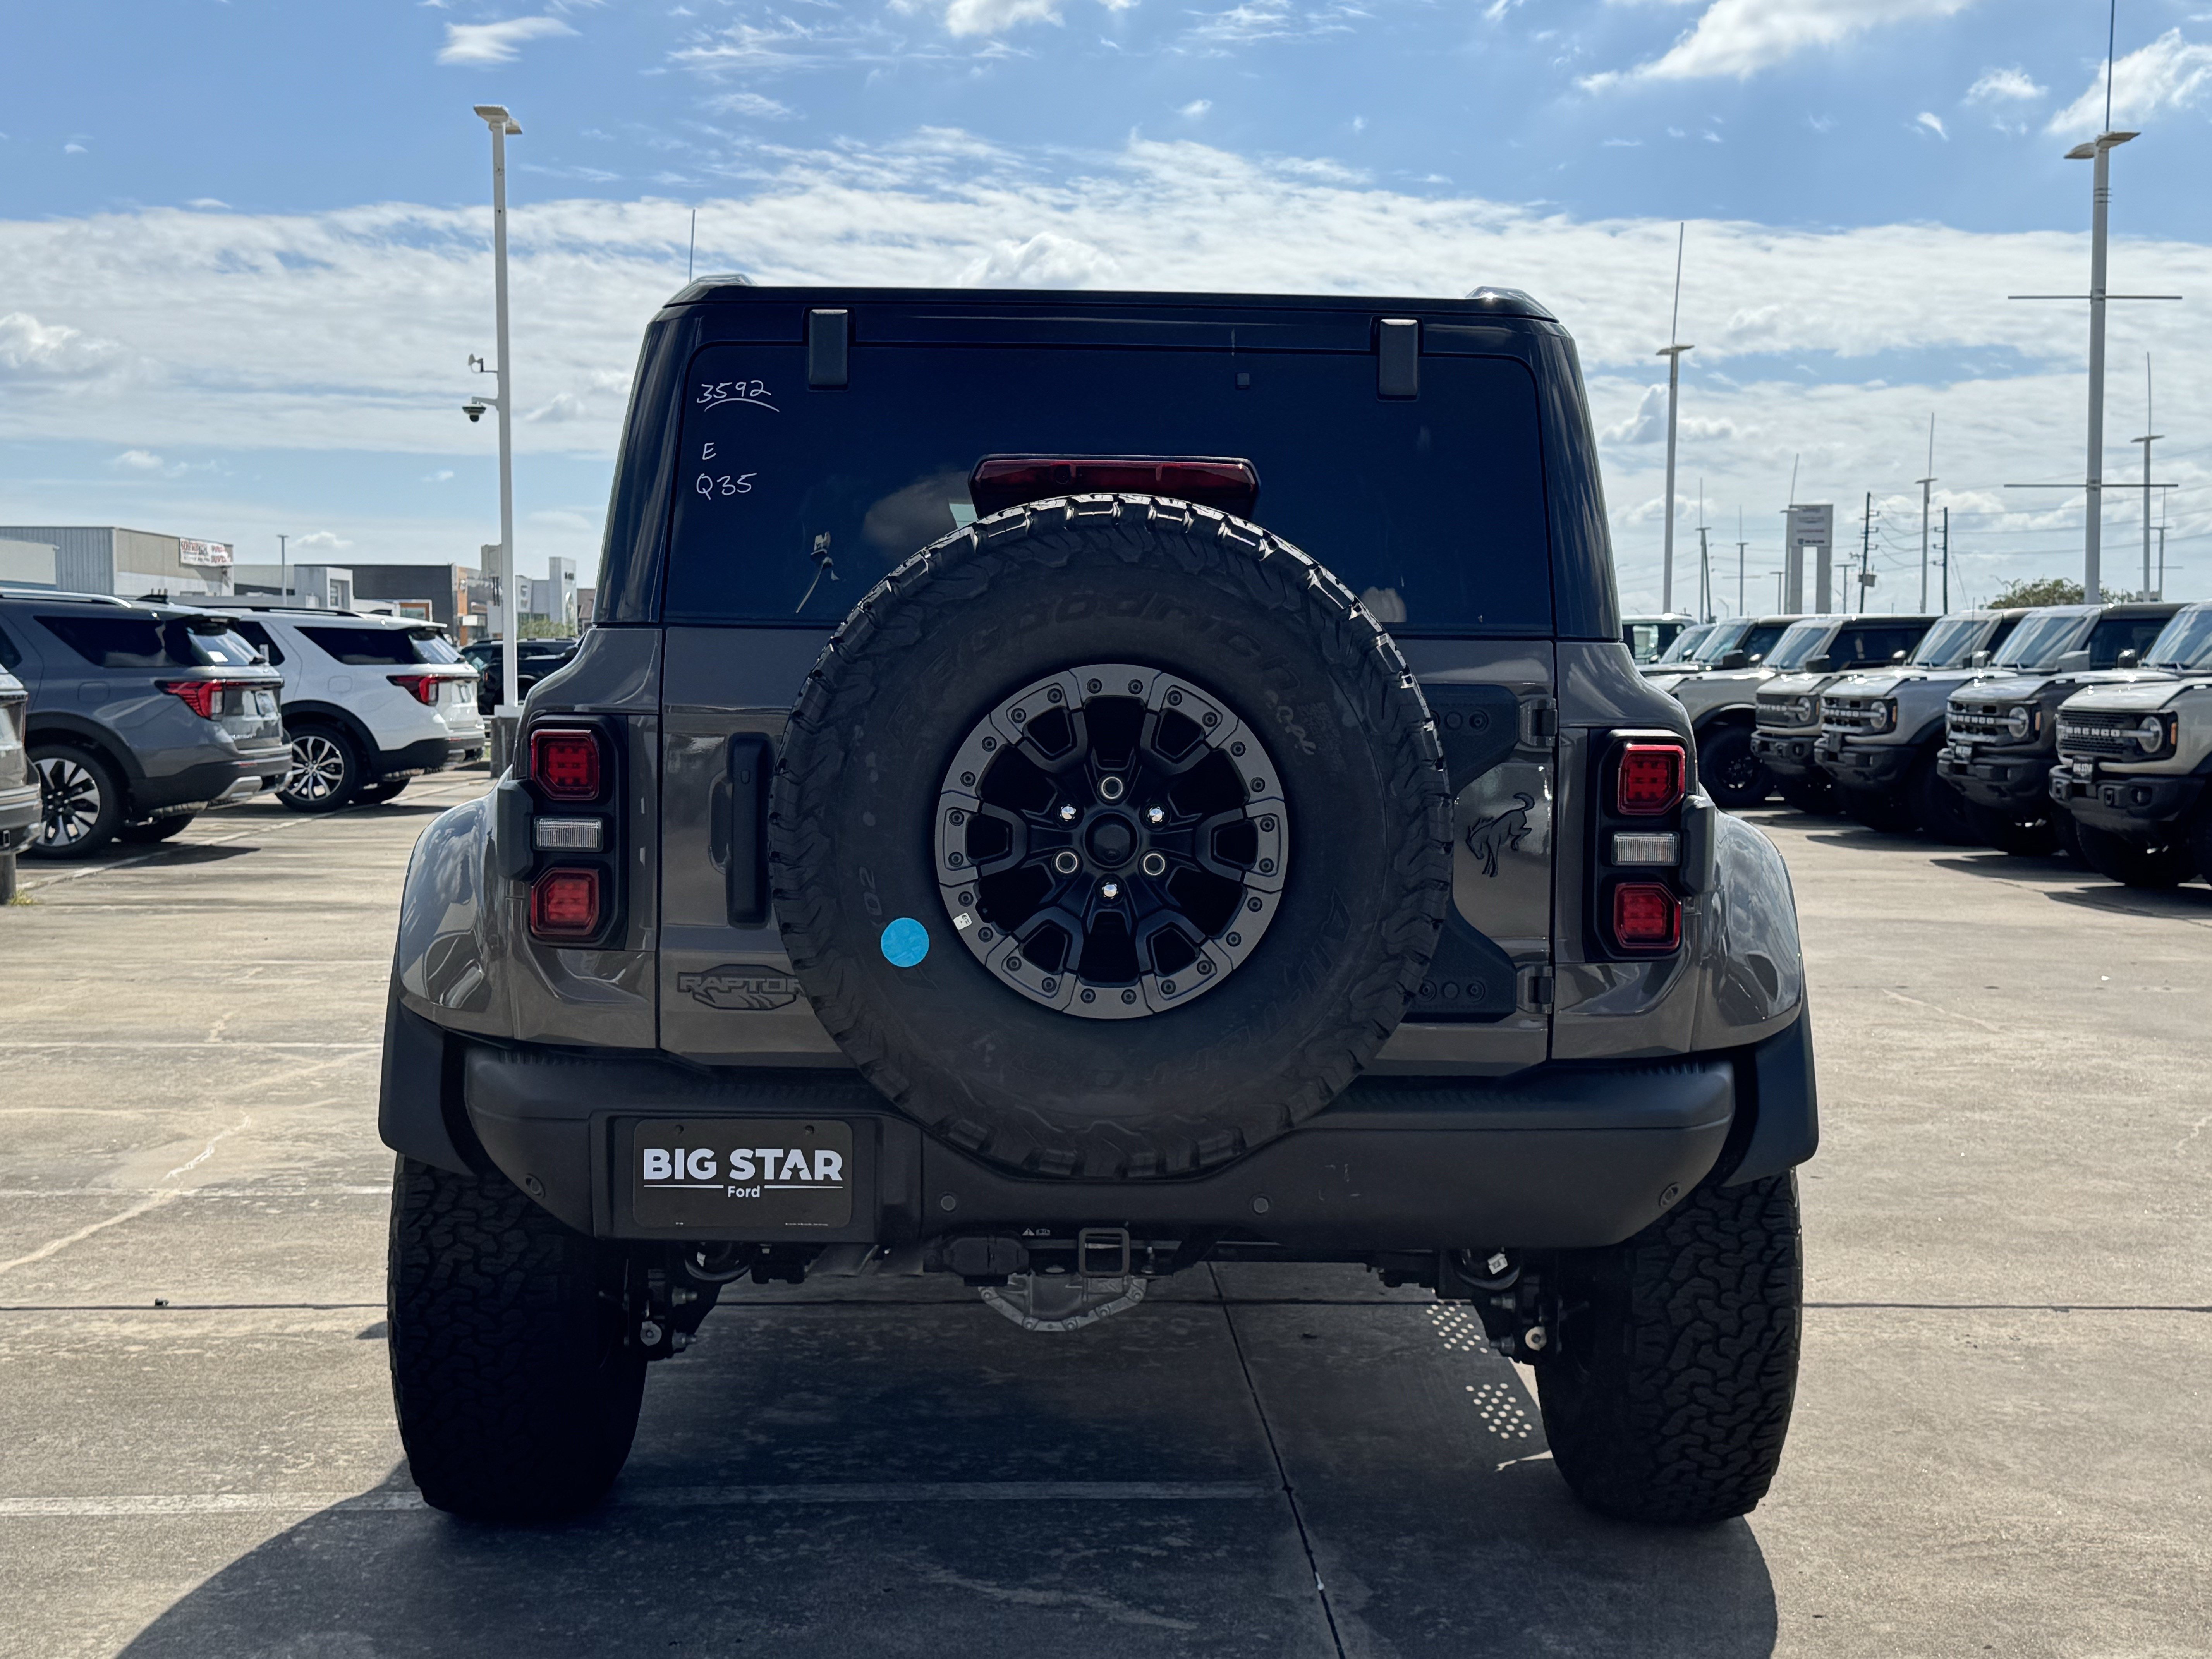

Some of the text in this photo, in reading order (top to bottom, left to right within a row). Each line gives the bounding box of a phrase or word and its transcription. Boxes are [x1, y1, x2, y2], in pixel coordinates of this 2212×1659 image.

[697, 380, 771, 403] 3592
[702, 442, 716, 460] E
[696, 472, 757, 500] Q35
[677, 972, 805, 1003] RAPTOR
[643, 1148, 843, 1181] BIG STAR
[728, 1185, 761, 1198] Ford
